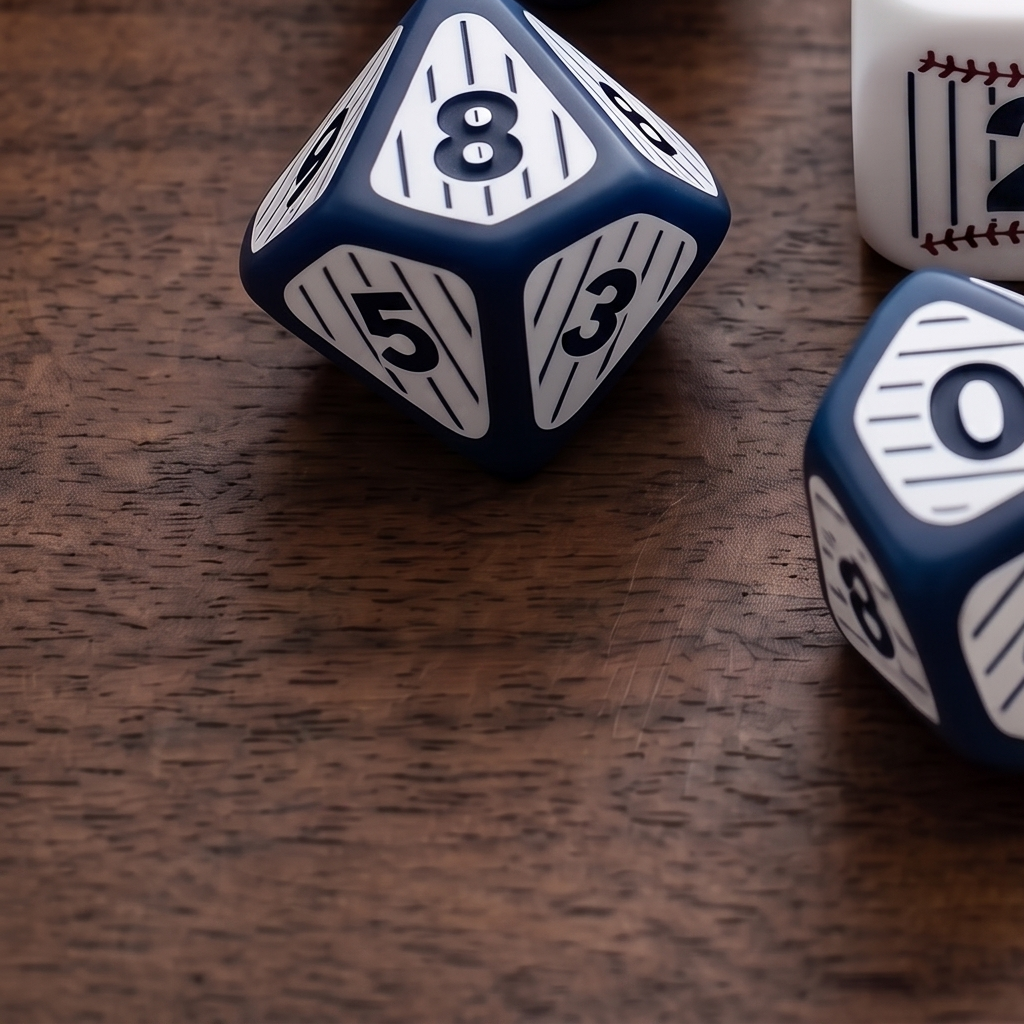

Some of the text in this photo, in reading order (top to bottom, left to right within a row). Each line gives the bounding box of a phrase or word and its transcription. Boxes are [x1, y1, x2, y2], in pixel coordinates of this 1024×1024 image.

[434, 90, 523, 182] 8
[351, 291, 439, 372] 5
[561, 268, 637, 356] 3
